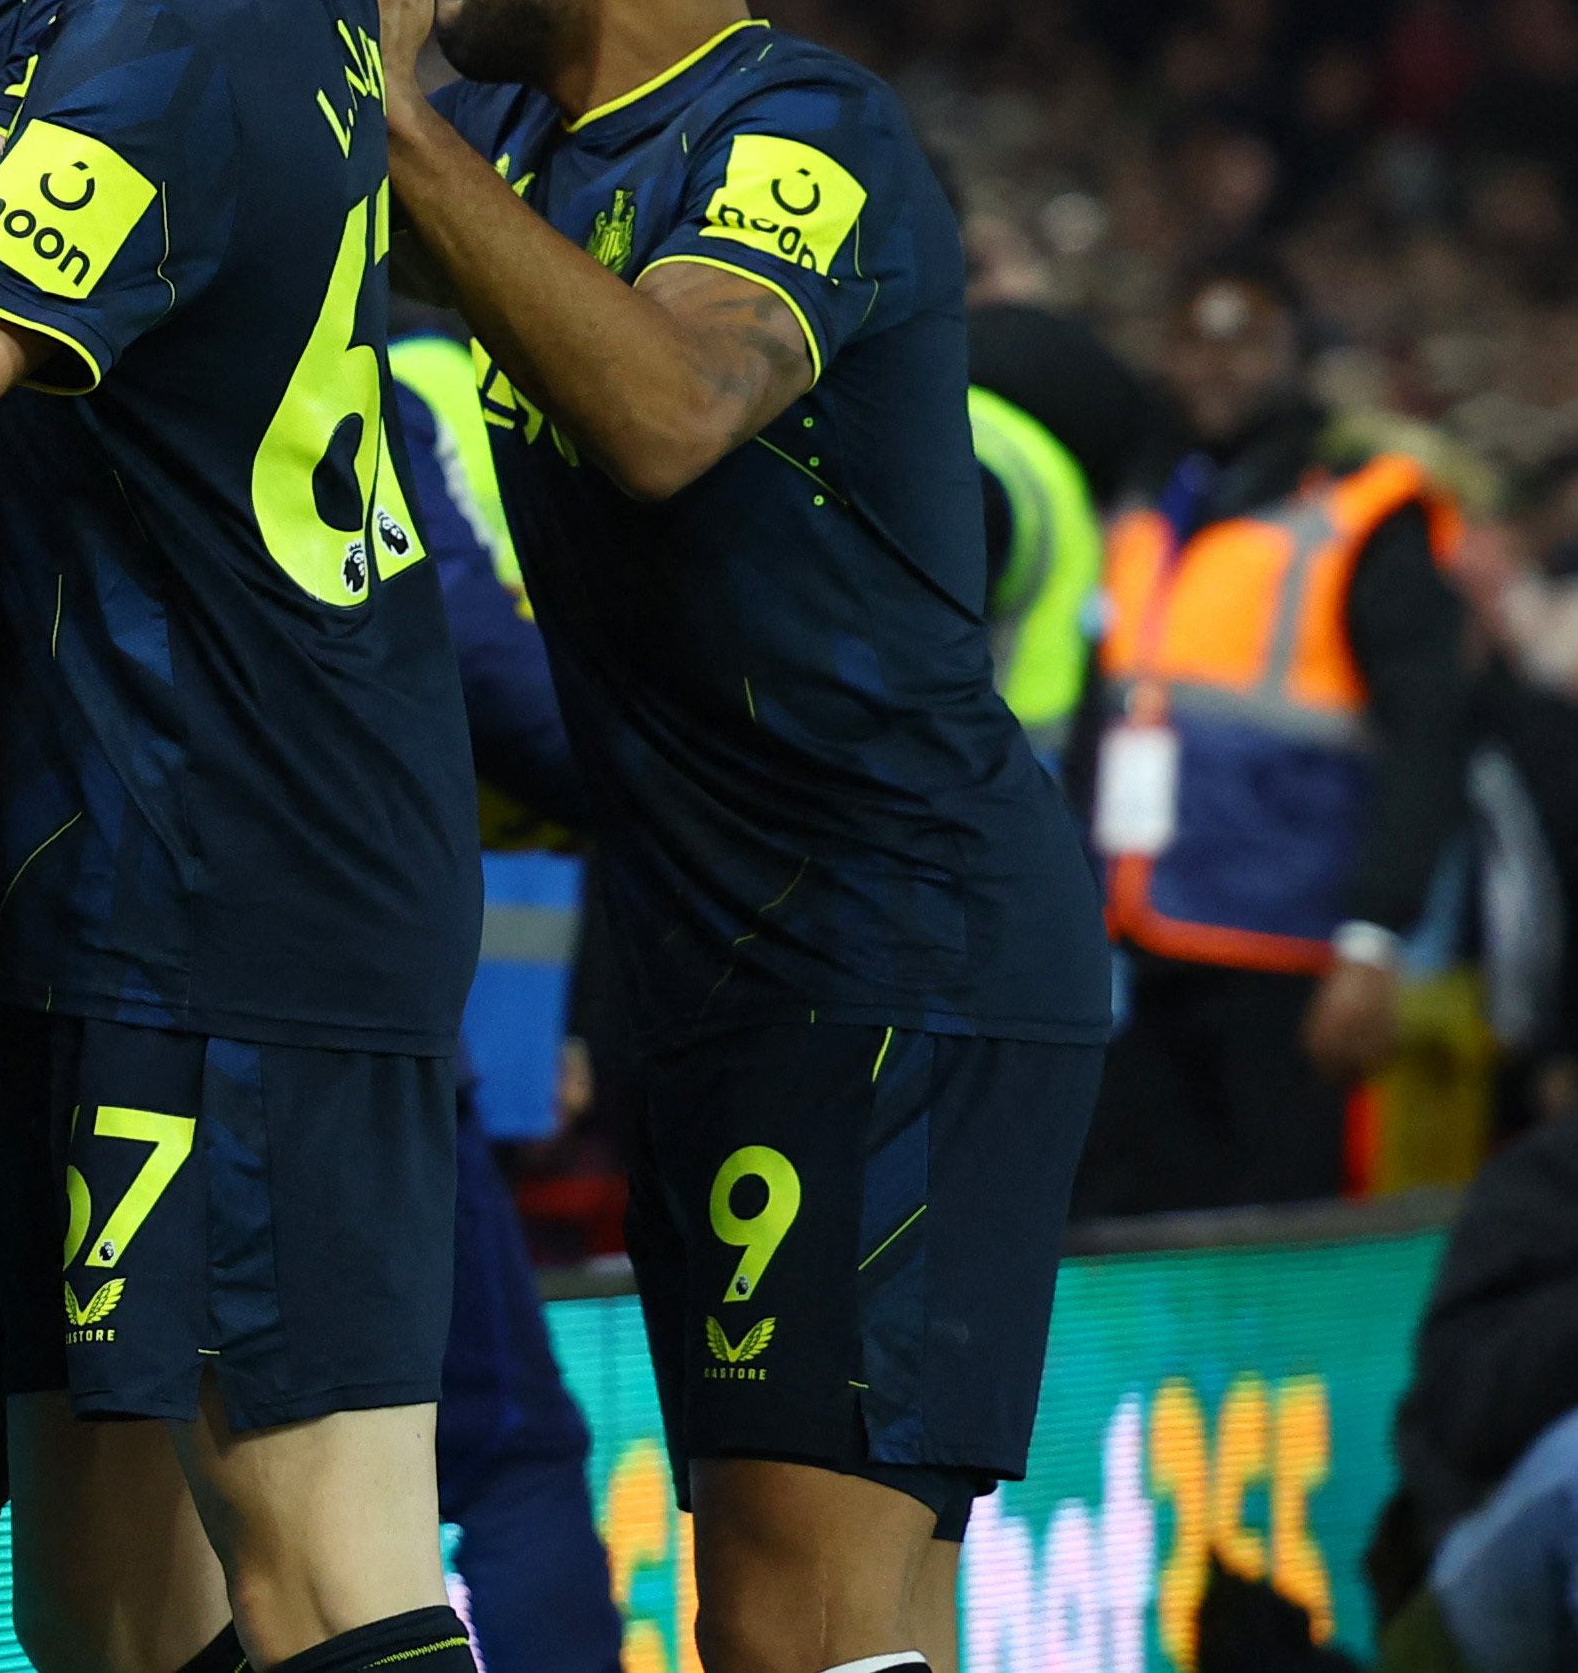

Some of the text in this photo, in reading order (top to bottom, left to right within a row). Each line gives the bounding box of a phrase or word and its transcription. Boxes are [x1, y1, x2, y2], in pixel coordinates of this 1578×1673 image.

[709, 1144, 802, 1304] 9
[65, 1329, 116, 1346] STORE
[703, 1367, 768, 1382] CASTORE
